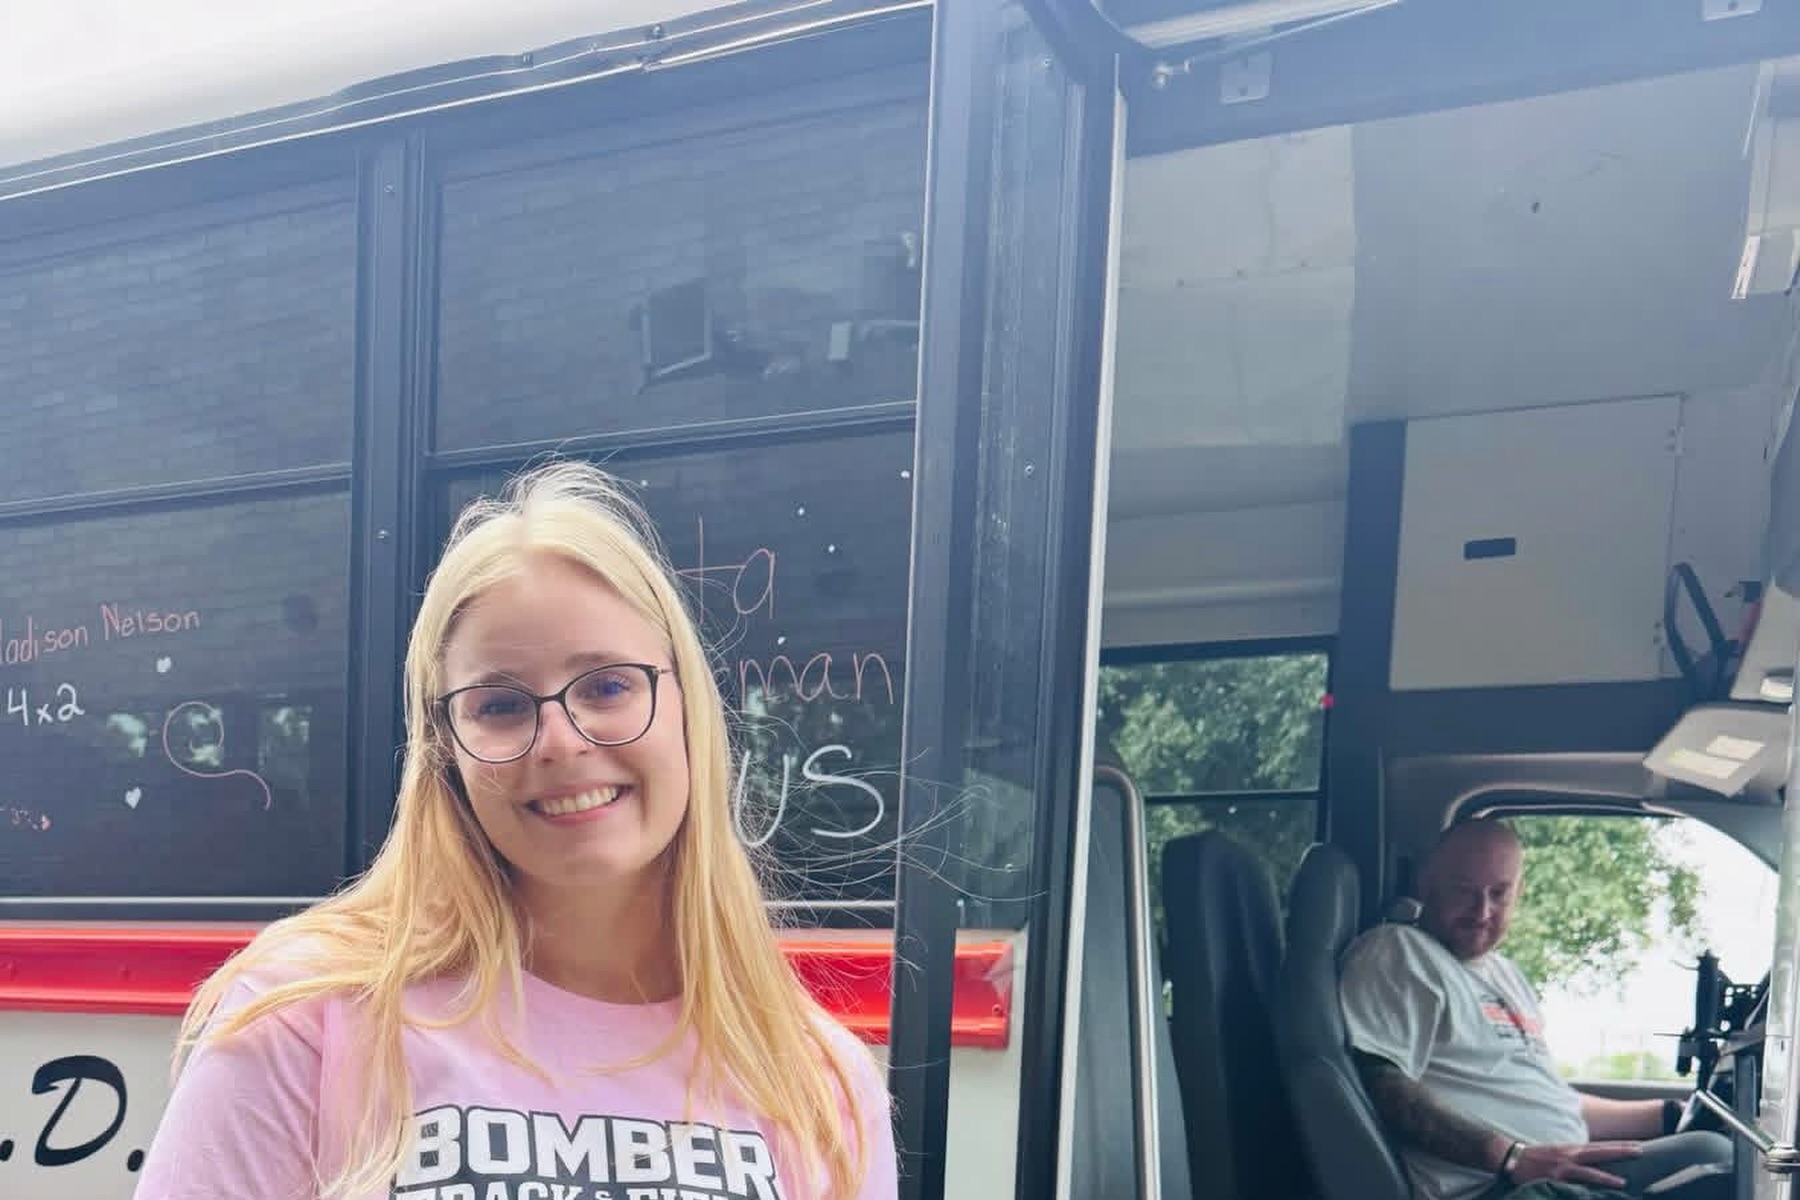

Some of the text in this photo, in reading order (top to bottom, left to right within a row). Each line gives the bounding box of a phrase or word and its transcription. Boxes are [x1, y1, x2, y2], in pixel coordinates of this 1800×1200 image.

[0, 602, 200, 665] adison Nelson
[7, 683, 85, 727] 4x2
